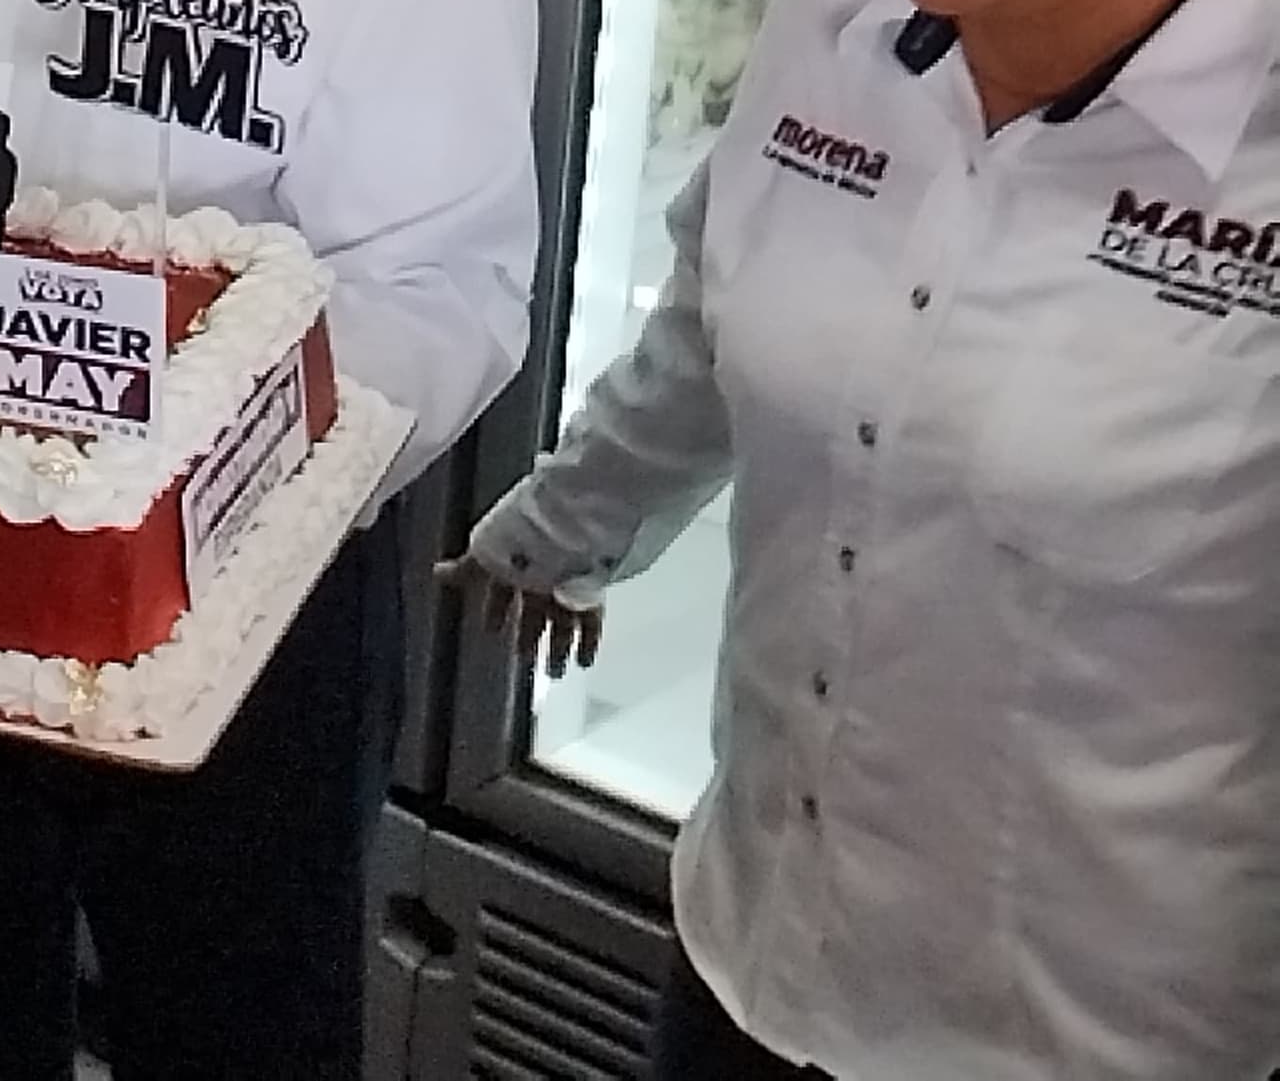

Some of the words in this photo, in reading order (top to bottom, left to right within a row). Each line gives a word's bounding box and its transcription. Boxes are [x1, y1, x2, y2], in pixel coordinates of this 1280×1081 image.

[47, 4, 284, 154] J.M.
[772, 115, 890, 180] morena
[1101, 228, 1149, 262] DE
[1157, 244, 1201, 274] LA
